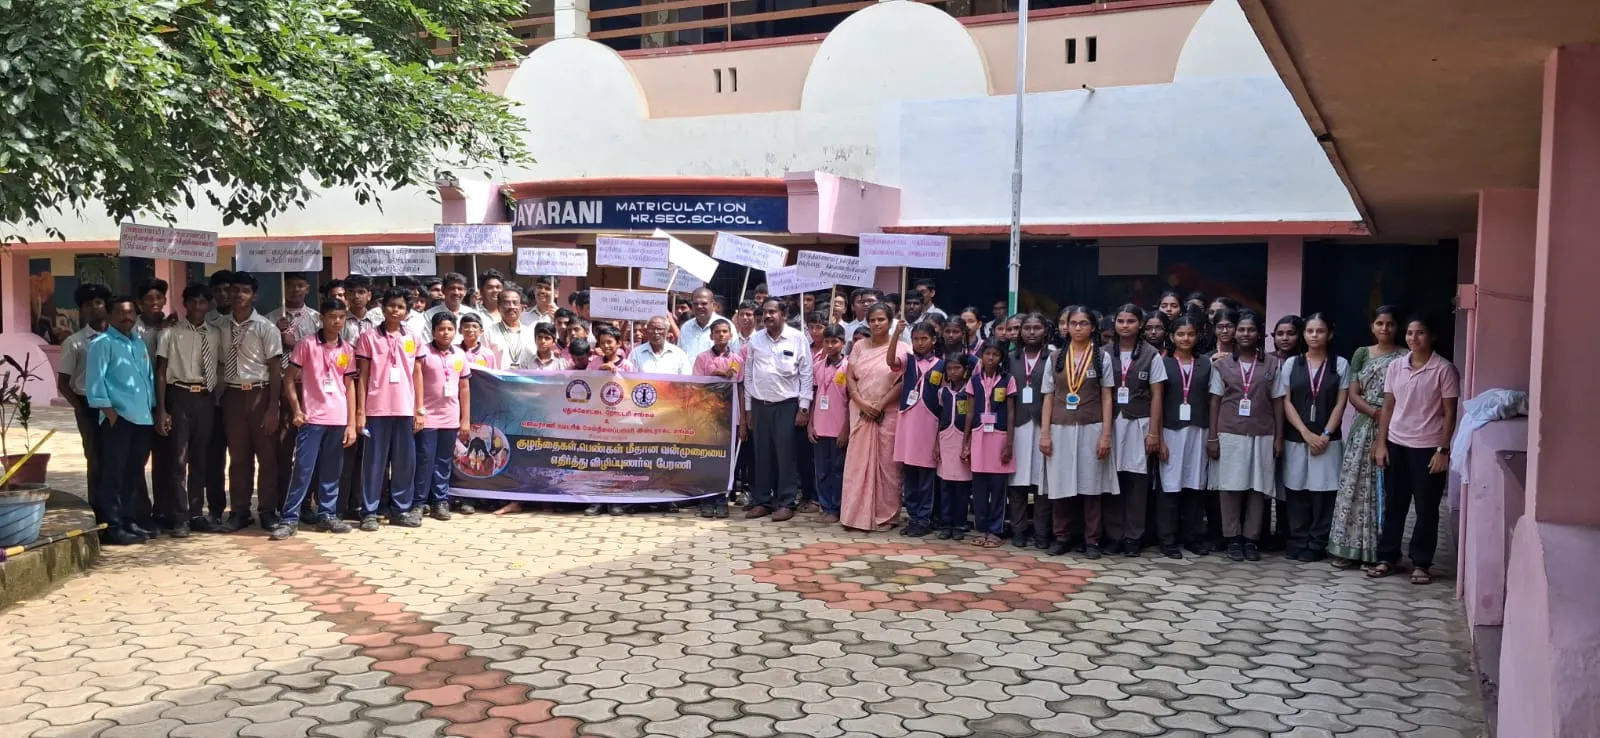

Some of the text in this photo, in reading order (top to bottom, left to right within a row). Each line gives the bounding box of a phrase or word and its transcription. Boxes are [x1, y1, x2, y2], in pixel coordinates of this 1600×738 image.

[512, 200, 603, 226] JAYARANI
[616, 201, 746, 212] MATRICULATION
[631, 214, 762, 225] HR.SEC.SCHOOL.
[626, 442, 658, 456] மீதான
[660, 444, 727, 459] வன்முறையை
[550, 454, 692, 471] எதிர்த்து விழிப்புணர்வு பேரணி
